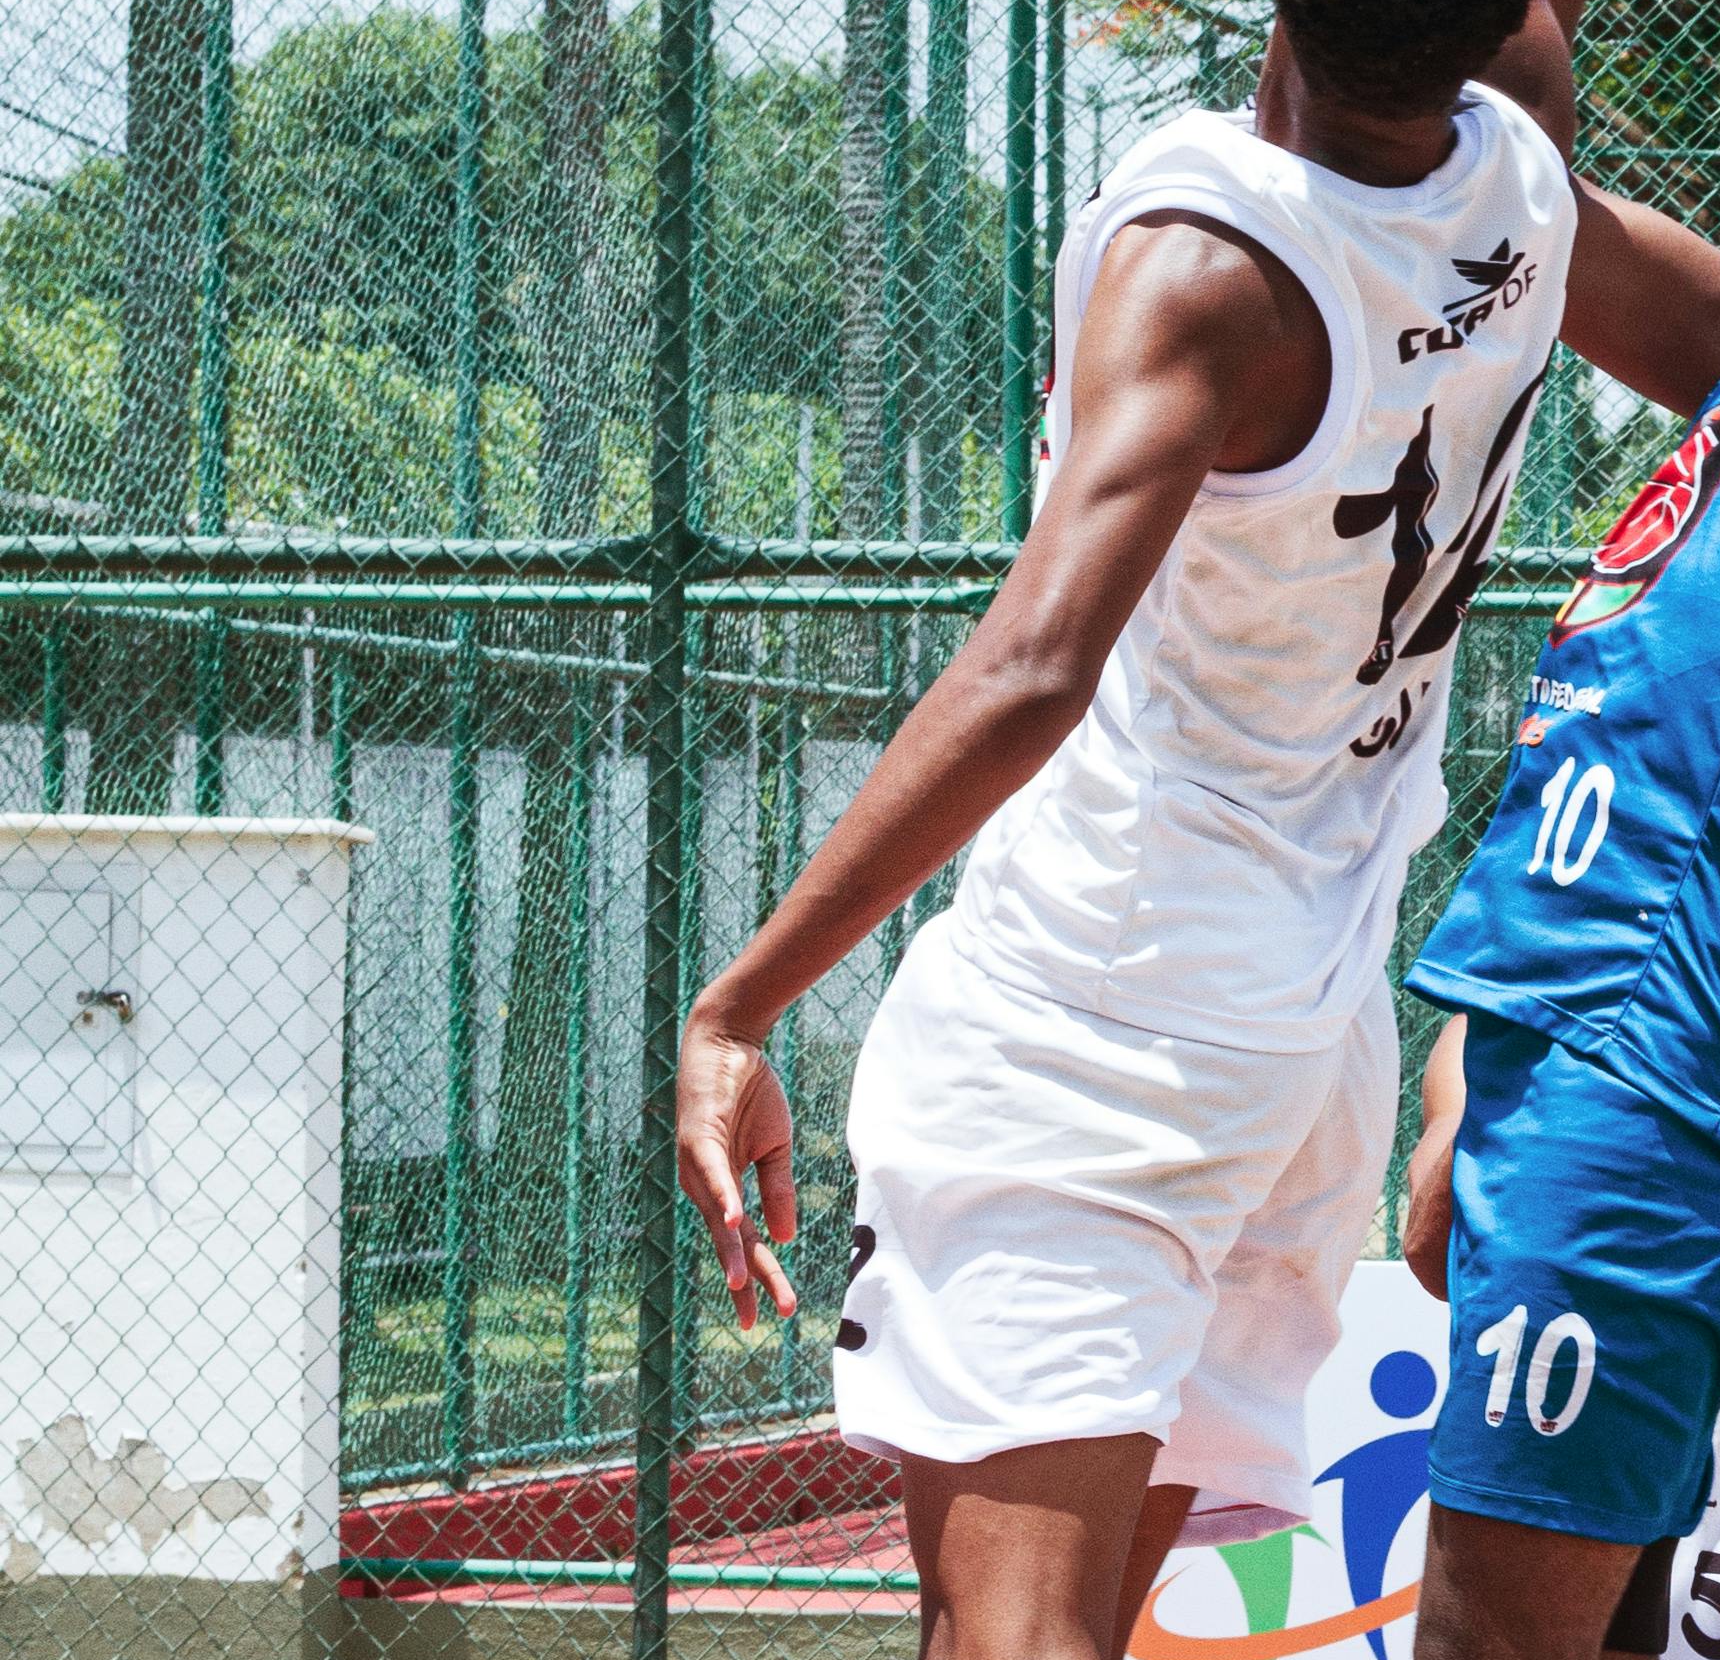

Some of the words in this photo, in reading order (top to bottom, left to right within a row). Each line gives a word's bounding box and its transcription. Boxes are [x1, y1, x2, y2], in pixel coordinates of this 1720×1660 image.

[1502, 264, 1538, 310] DF
[1527, 755, 1615, 886] 10
[1476, 1304, 1596, 1436] 10
